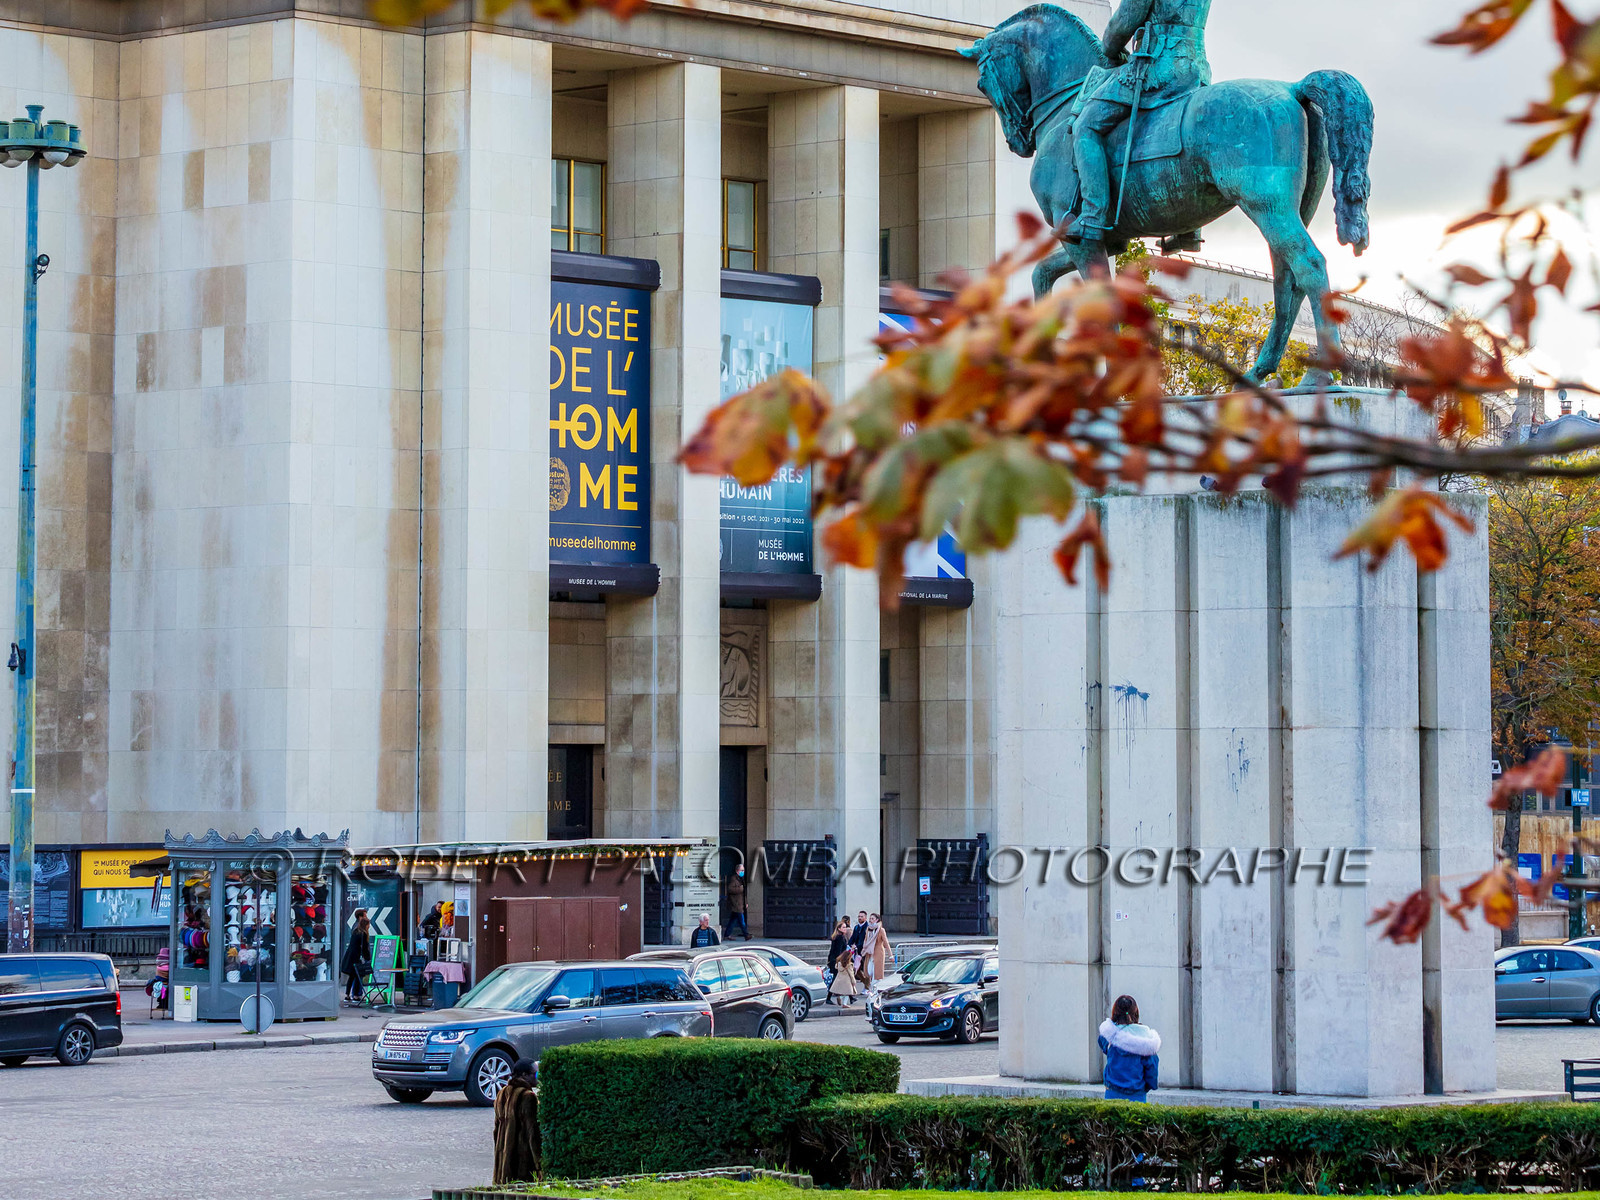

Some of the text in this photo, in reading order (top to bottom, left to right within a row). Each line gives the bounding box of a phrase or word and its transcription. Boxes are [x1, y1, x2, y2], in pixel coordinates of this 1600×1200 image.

[579, 462, 638, 511] ME
[758, 538, 782, 549] MUSÉE
[758, 551, 804, 562] DE L'HOMME
